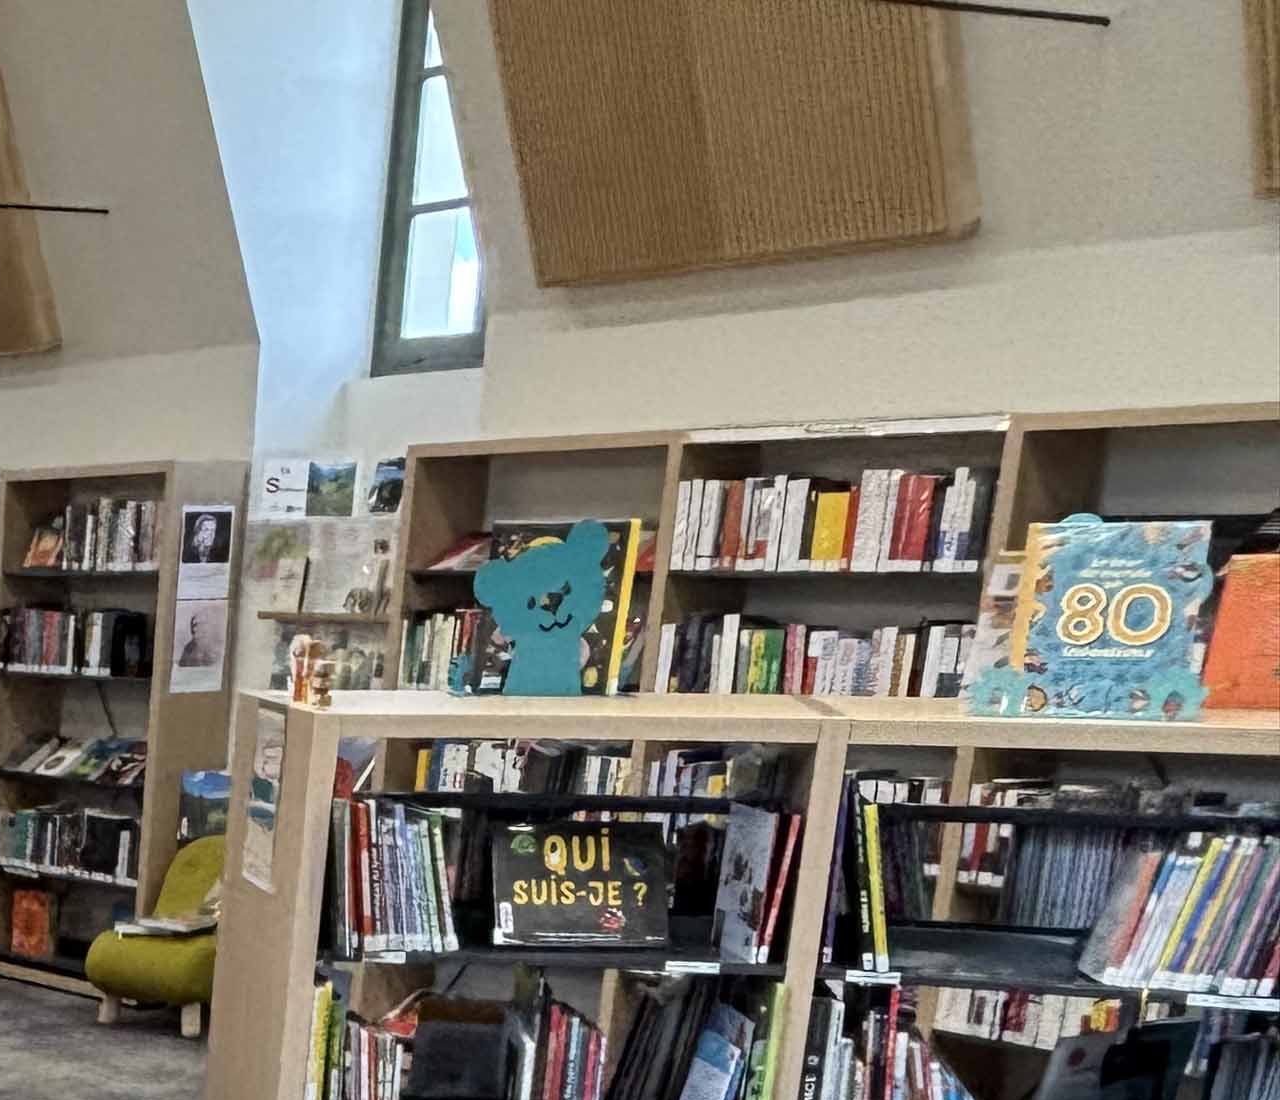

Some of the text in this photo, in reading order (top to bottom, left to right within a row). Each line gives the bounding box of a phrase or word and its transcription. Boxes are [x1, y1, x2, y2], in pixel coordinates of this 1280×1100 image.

[1055, 582, 1173, 647] 80
[543, 827, 611, 876] QUI
[632, 881, 648, 906] ?
